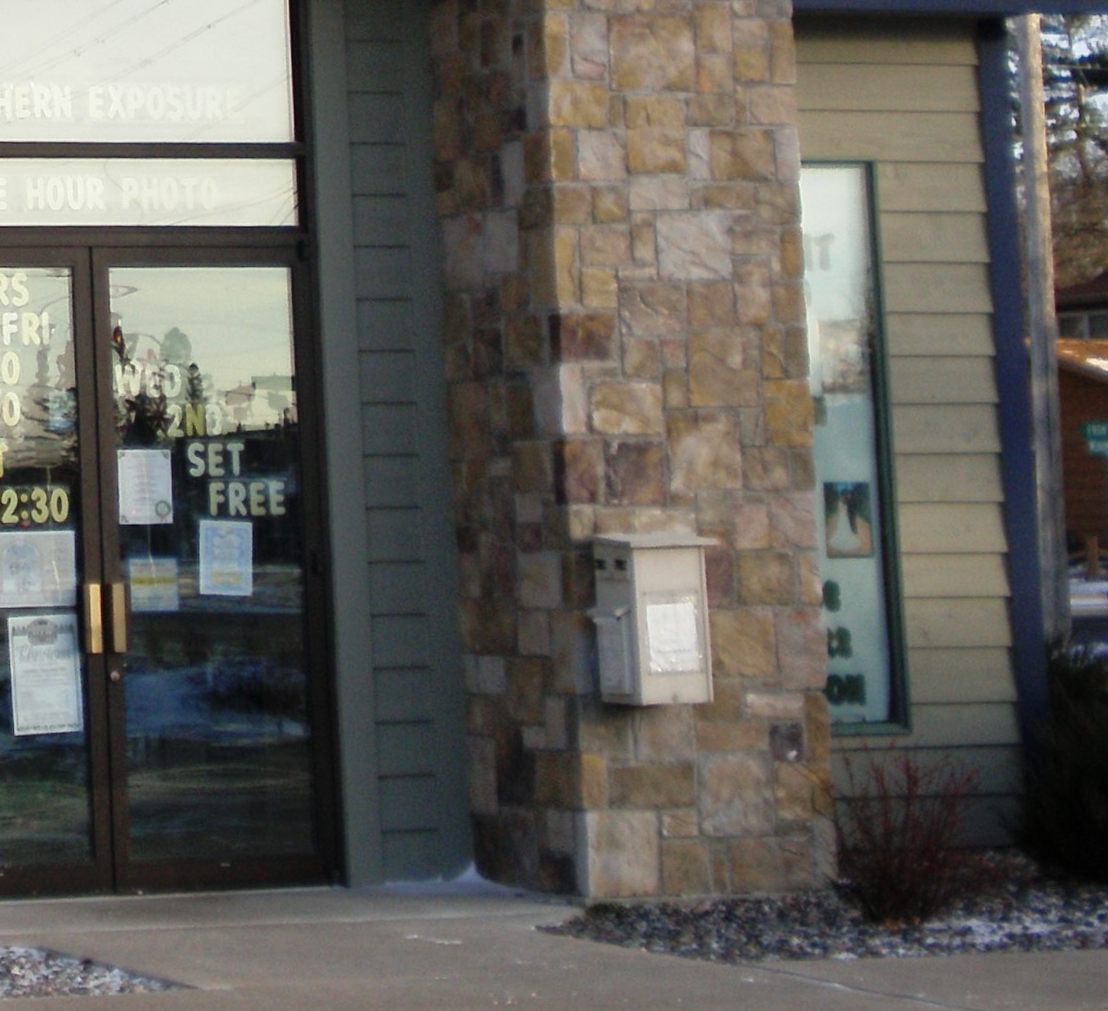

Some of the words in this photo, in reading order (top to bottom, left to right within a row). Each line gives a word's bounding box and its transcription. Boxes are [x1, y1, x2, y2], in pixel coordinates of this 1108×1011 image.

[89, 86, 243, 119] EXPOSURE
[26, 176, 105, 210] HOUR
[121, 176, 219, 210] PHOTO
[187, 442, 245, 478] SET
[209, 482, 287, 517] FREE
